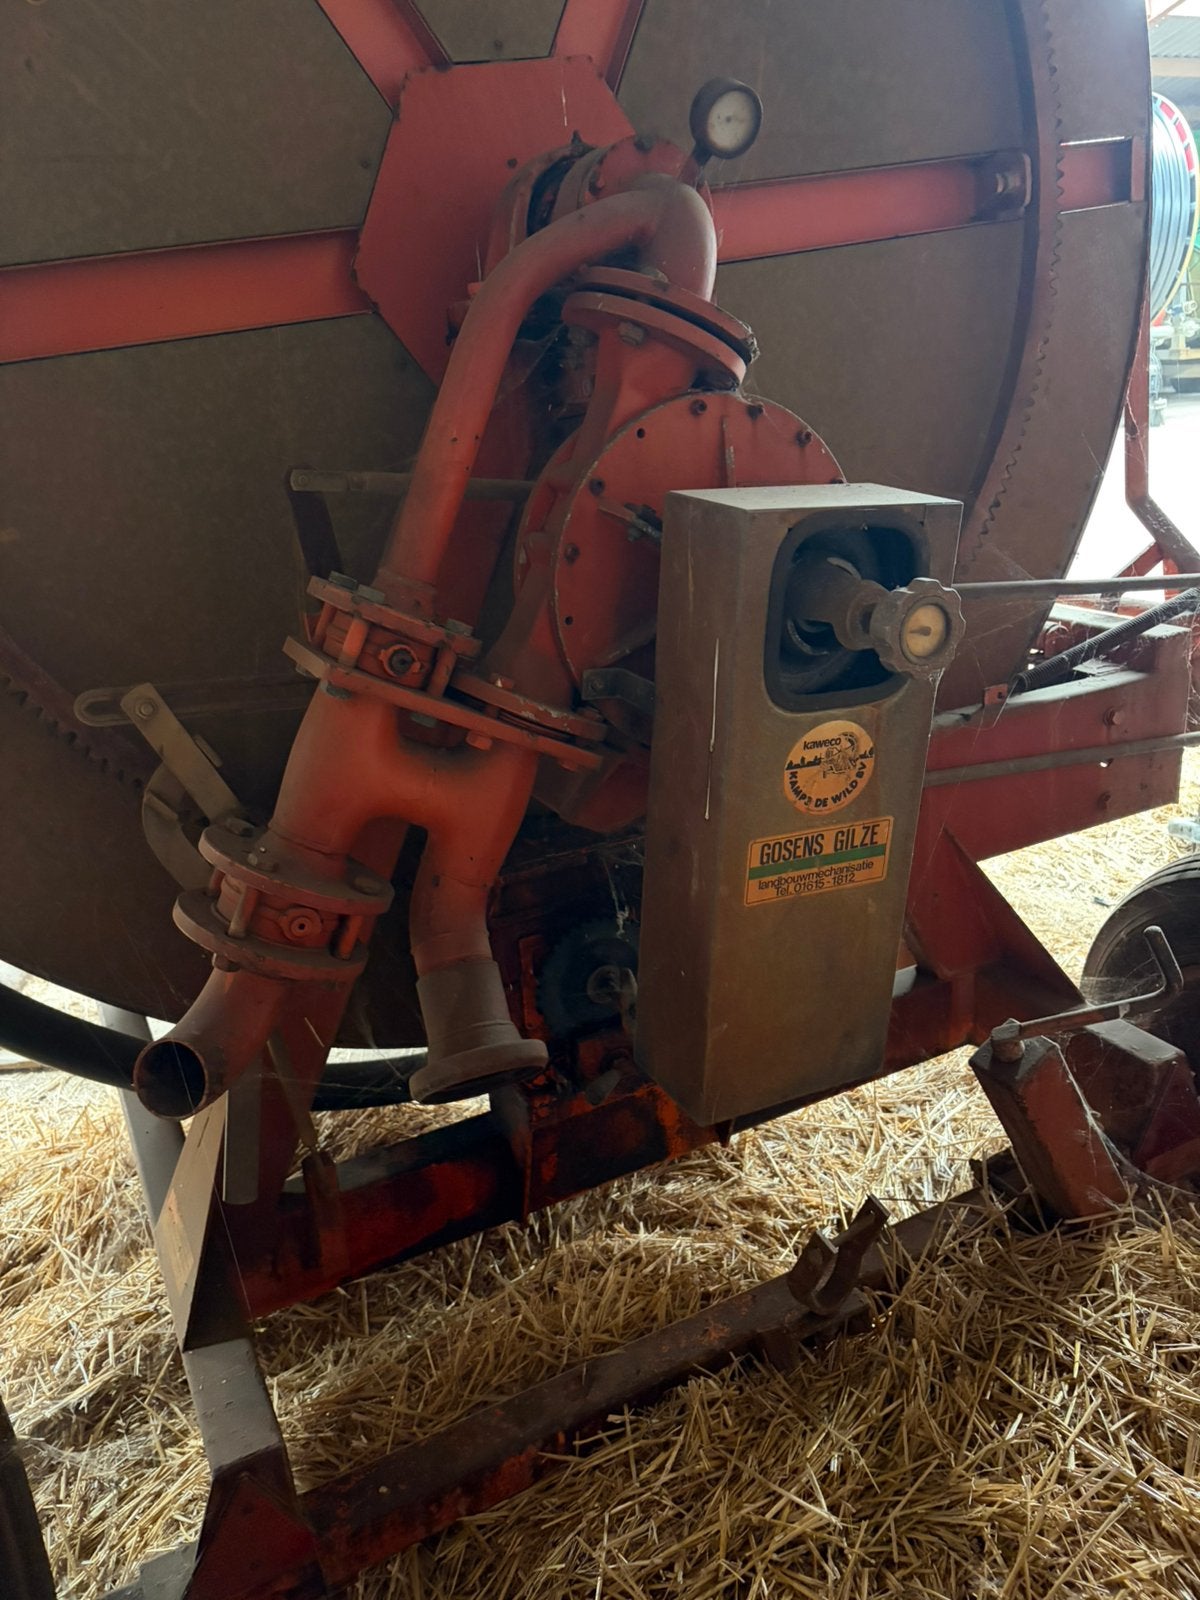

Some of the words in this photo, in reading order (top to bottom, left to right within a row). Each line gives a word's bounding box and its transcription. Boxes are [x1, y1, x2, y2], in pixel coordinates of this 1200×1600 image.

[803, 737, 841, 751] kaweco
[814, 797, 828, 808] DE
[831, 779, 858, 804] WILD
[760, 833, 824, 865] GOSENS
[833, 824, 880, 852] GILZE
[758, 860, 874, 890] landbouwmechanisatie
[775, 884, 792, 897] Tel.
